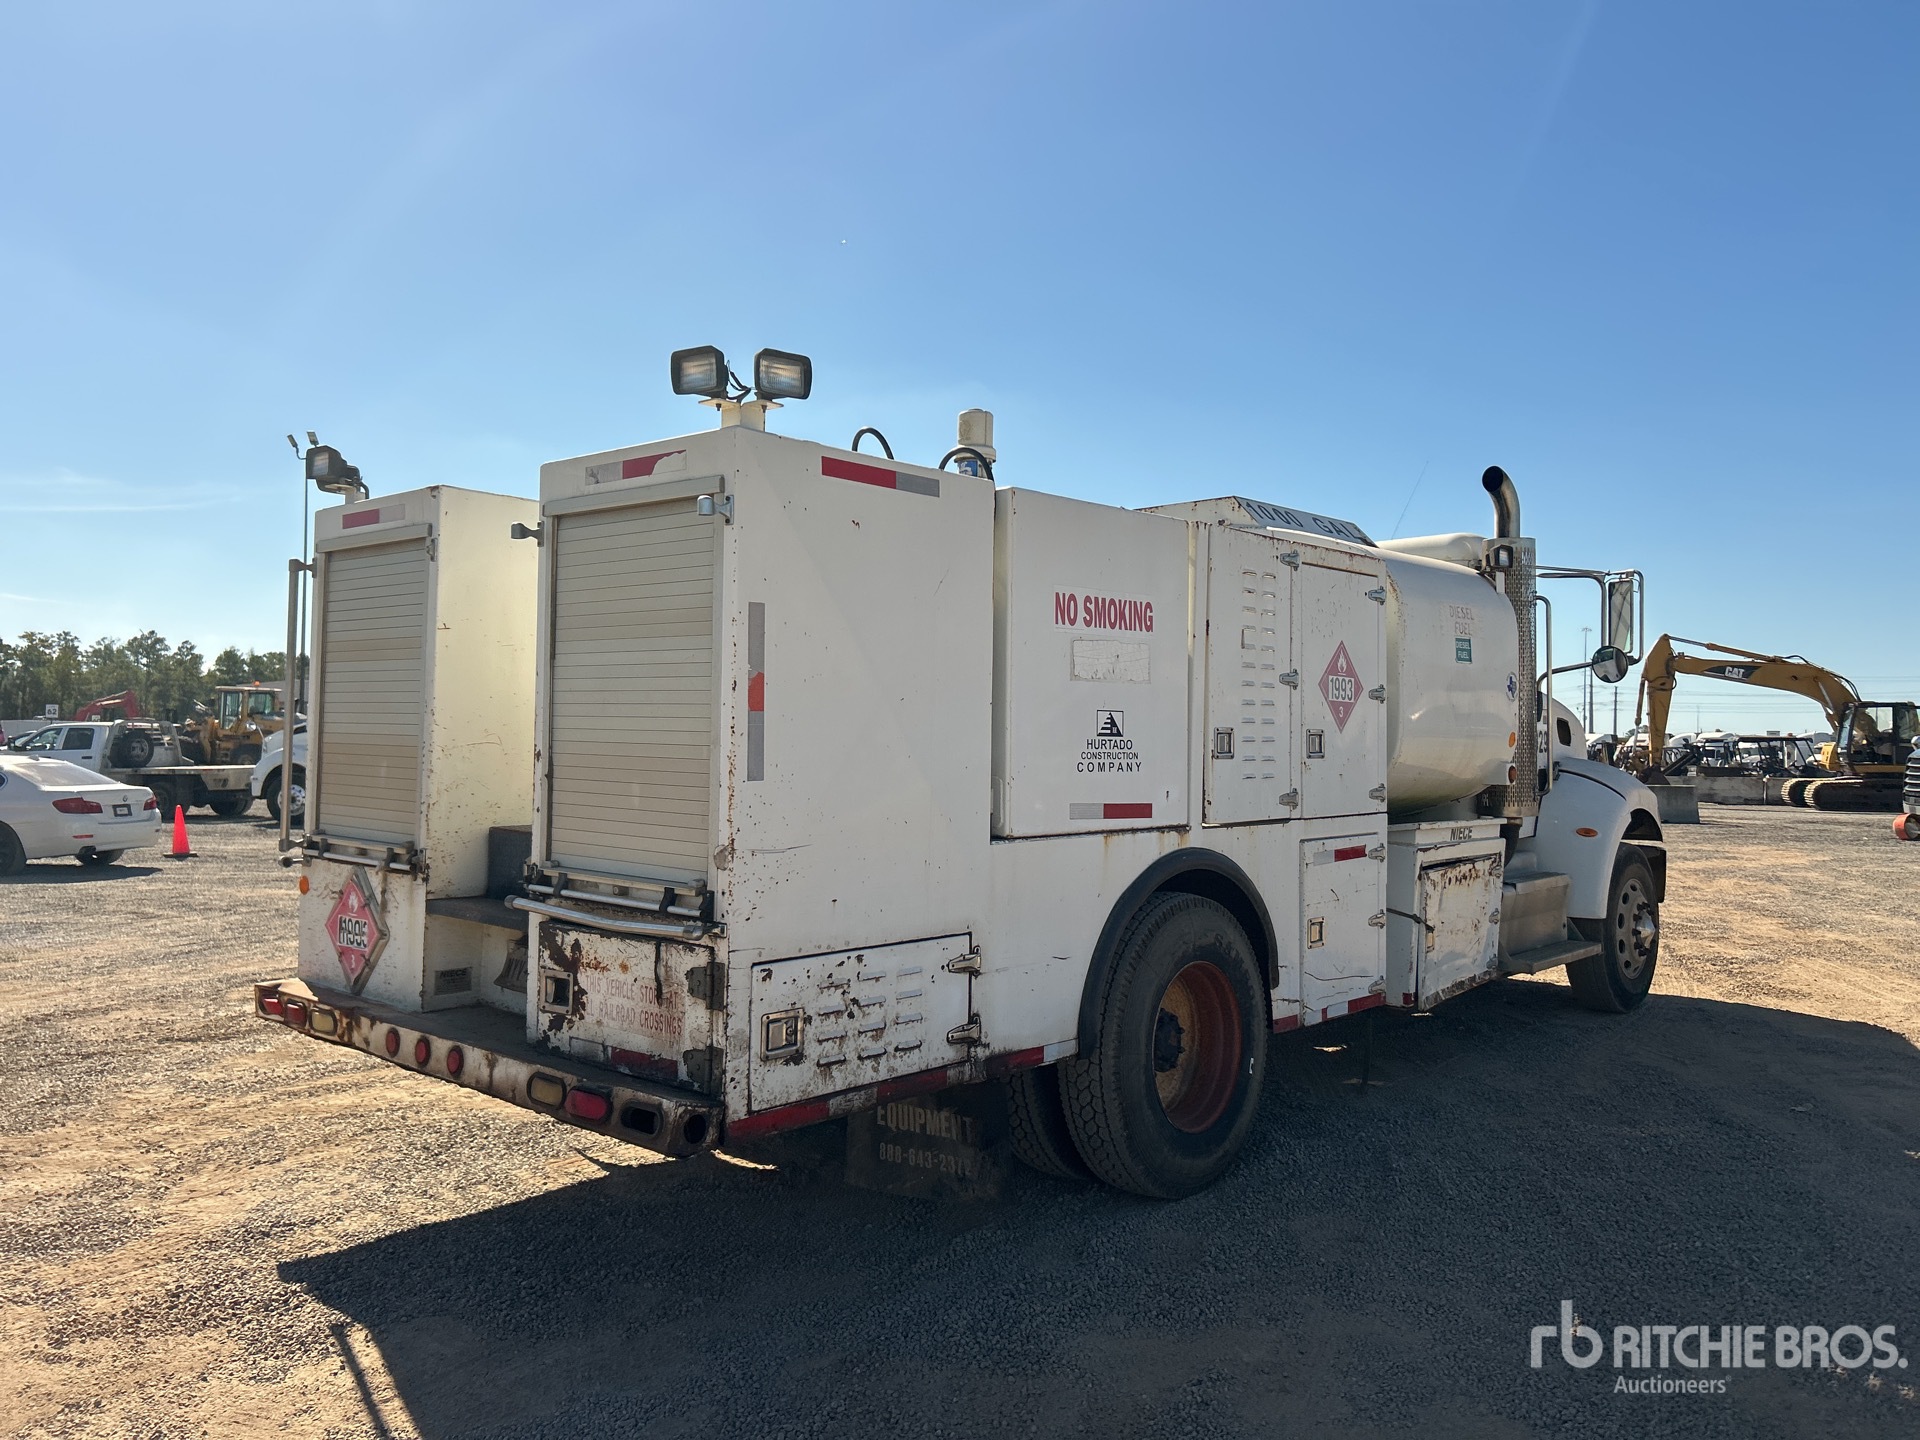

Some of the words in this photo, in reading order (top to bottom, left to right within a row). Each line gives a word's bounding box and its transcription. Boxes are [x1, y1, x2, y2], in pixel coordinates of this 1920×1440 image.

[1246, 501, 1303, 528] 1000
[1312, 516, 1362, 539] GAL
[1055, 591, 1078, 626] NO
[1083, 595, 1153, 633] SMOKING
[1449, 605, 1474, 620] DIESEL
[1455, 621, 1472, 636] FUEL
[1456, 641, 1471, 649] DIESEL
[1458, 650, 1469, 659] FUEL
[1725, 666, 1744, 678] CAT
[1330, 677, 1353, 701] 1993
[1339, 706, 1343, 717] 3
[1086, 739, 1133, 750] HURTADO
[1081, 751, 1139, 760] CONSTRUCTION
[1077, 761, 1142, 773] COMPANY
[1450, 826, 1473, 841] NIECE
[585, 974, 601, 994] THIS
[606, 978, 635, 1001] VEHICLE
[599, 1001, 636, 1026] RAILROAD
[640, 1010, 682, 1035] CROSSINGS
[876, 1103, 976, 1145] EQUIPMENT
